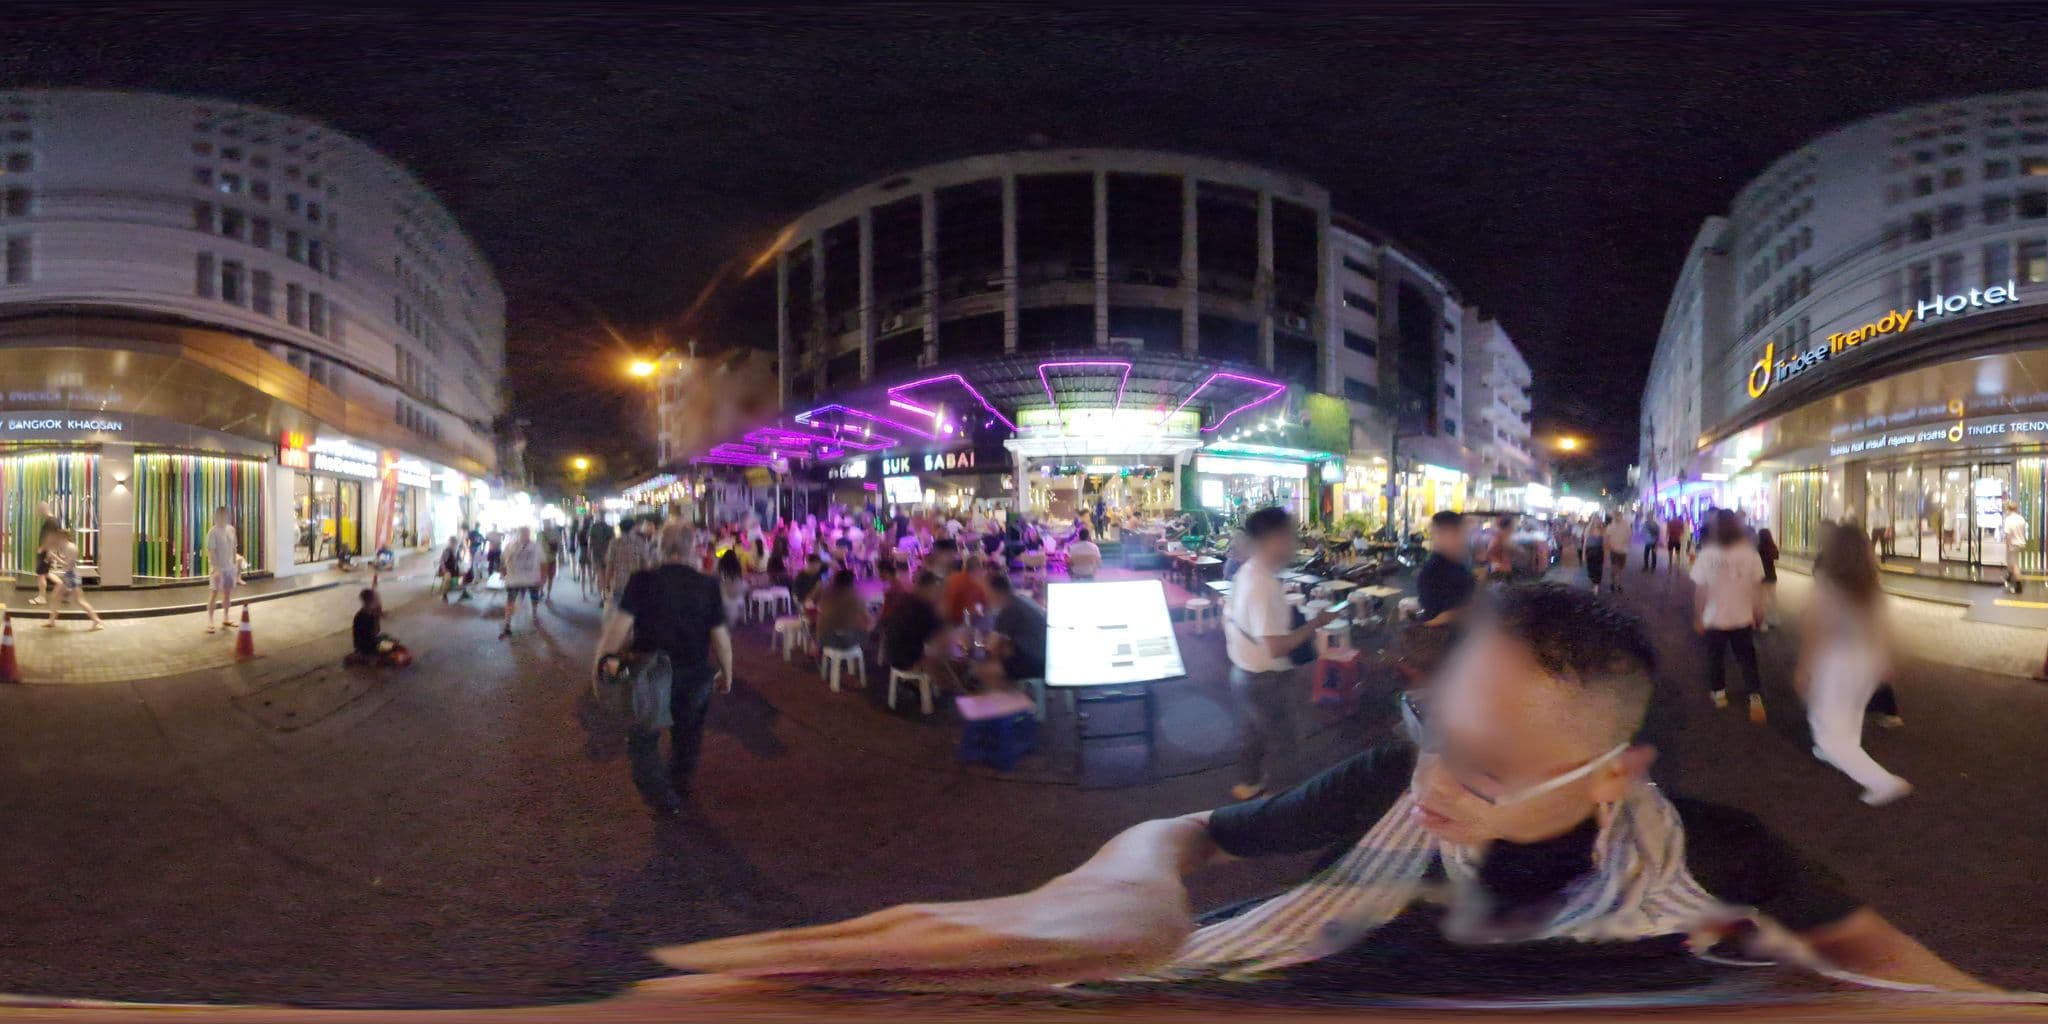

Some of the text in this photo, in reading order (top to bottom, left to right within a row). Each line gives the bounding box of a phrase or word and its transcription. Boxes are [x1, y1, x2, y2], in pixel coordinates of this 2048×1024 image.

[1774, 344, 1828, 383] Tinidee
[1827, 308, 1914, 354] Trendy
[1917, 279, 2019, 320] Hotel
[8, 419, 122, 431] BANGKOK KHAOSAN
[1968, 423, 2006, 435] TINIDEE
